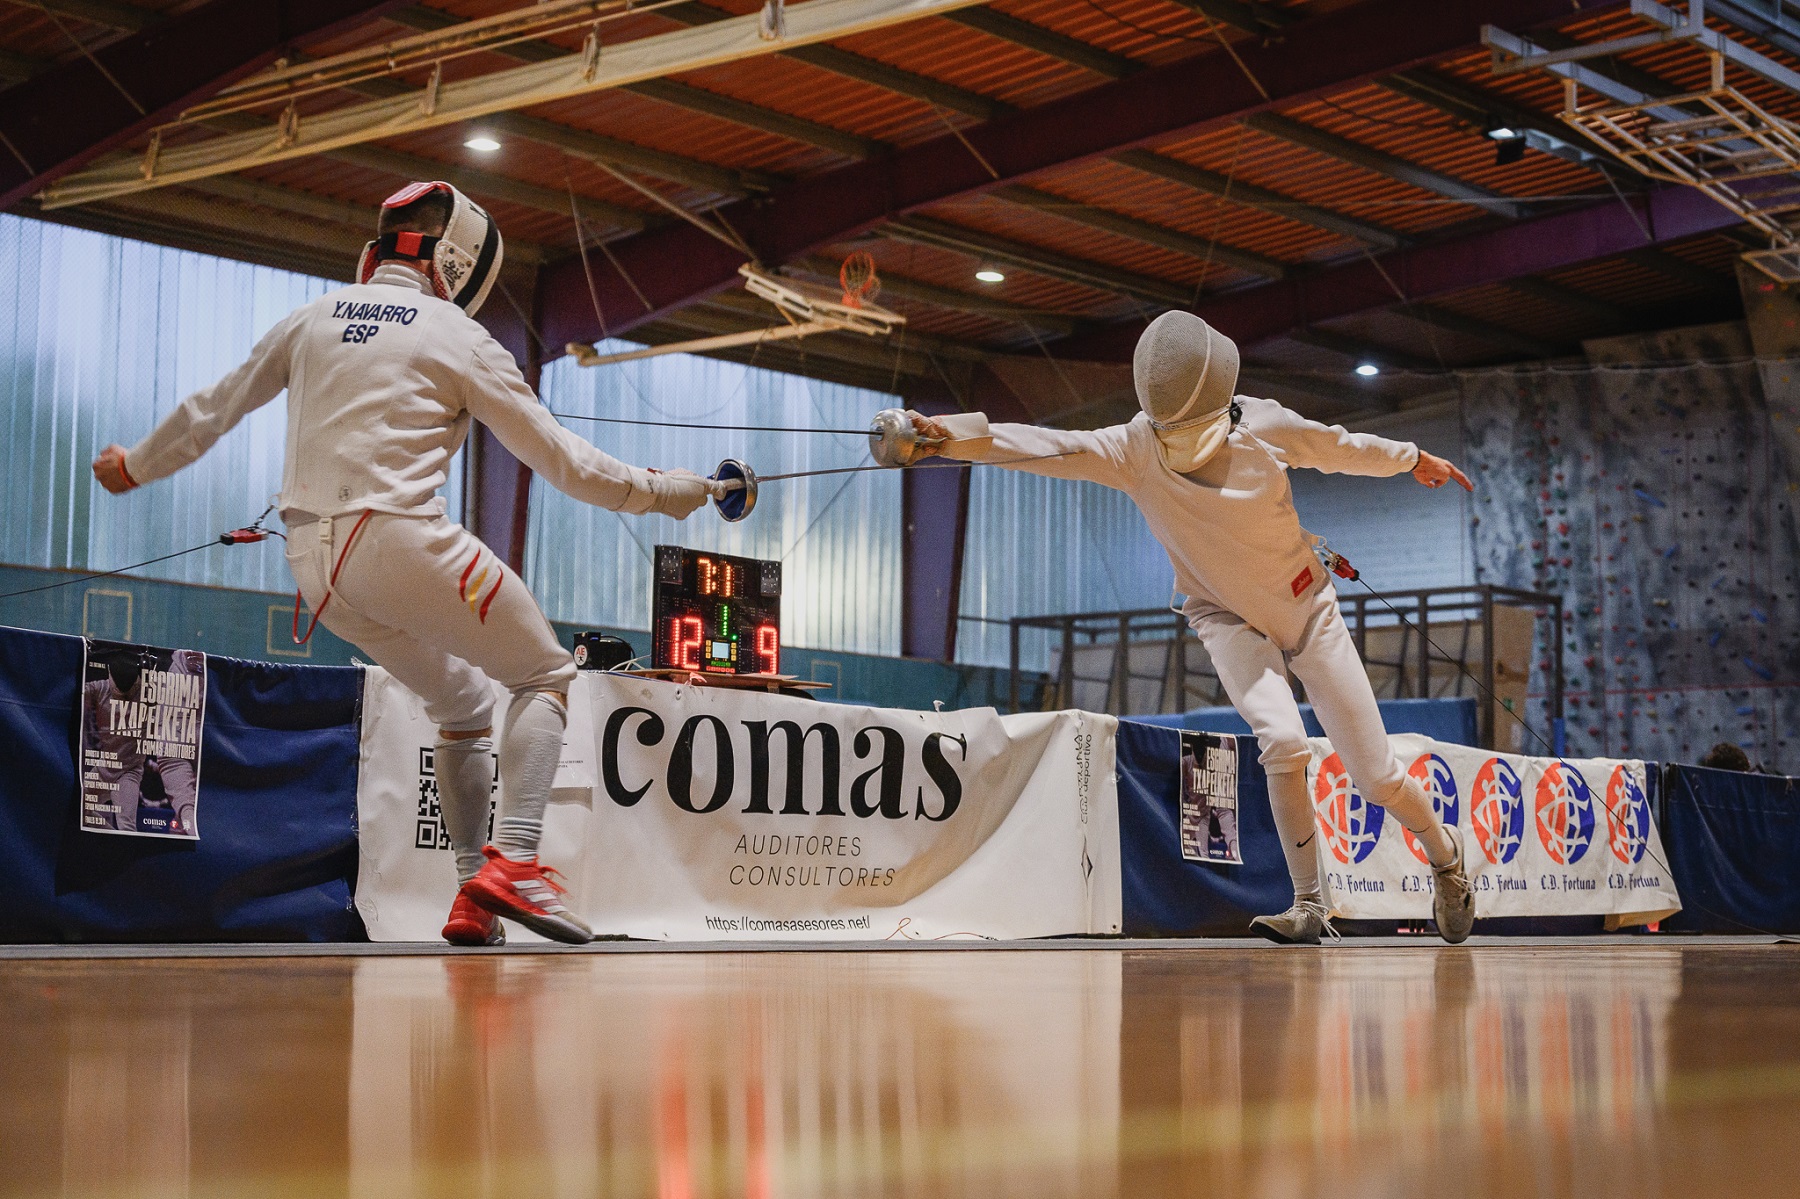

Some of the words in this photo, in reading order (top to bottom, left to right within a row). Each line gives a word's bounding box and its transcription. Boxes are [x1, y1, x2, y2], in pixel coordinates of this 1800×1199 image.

[332, 300, 418, 326] Y.NAVARRO
[342, 323, 379, 344] ESP
[671, 615, 703, 670] 12
[758, 625, 778, 675] 9
[109, 699, 197, 744] TXAPELKETA
[601, 705, 968, 822] comas
[1083, 733, 1092, 792] deportivo
[143, 818, 167, 827] comas
[734, 834, 862, 857] AUDITORES
[729, 865, 896, 887] CONSULTORES
[1346, 874, 1385, 894] Fortuna
[1540, 873, 1560, 890] C.D.
[1562, 874, 1596, 893] Fortuna
[1608, 873, 1627, 889] C.D.
[1628, 873, 1661, 891] Fortuna
[705, 915, 871, 934] https://comasasesores.net/
